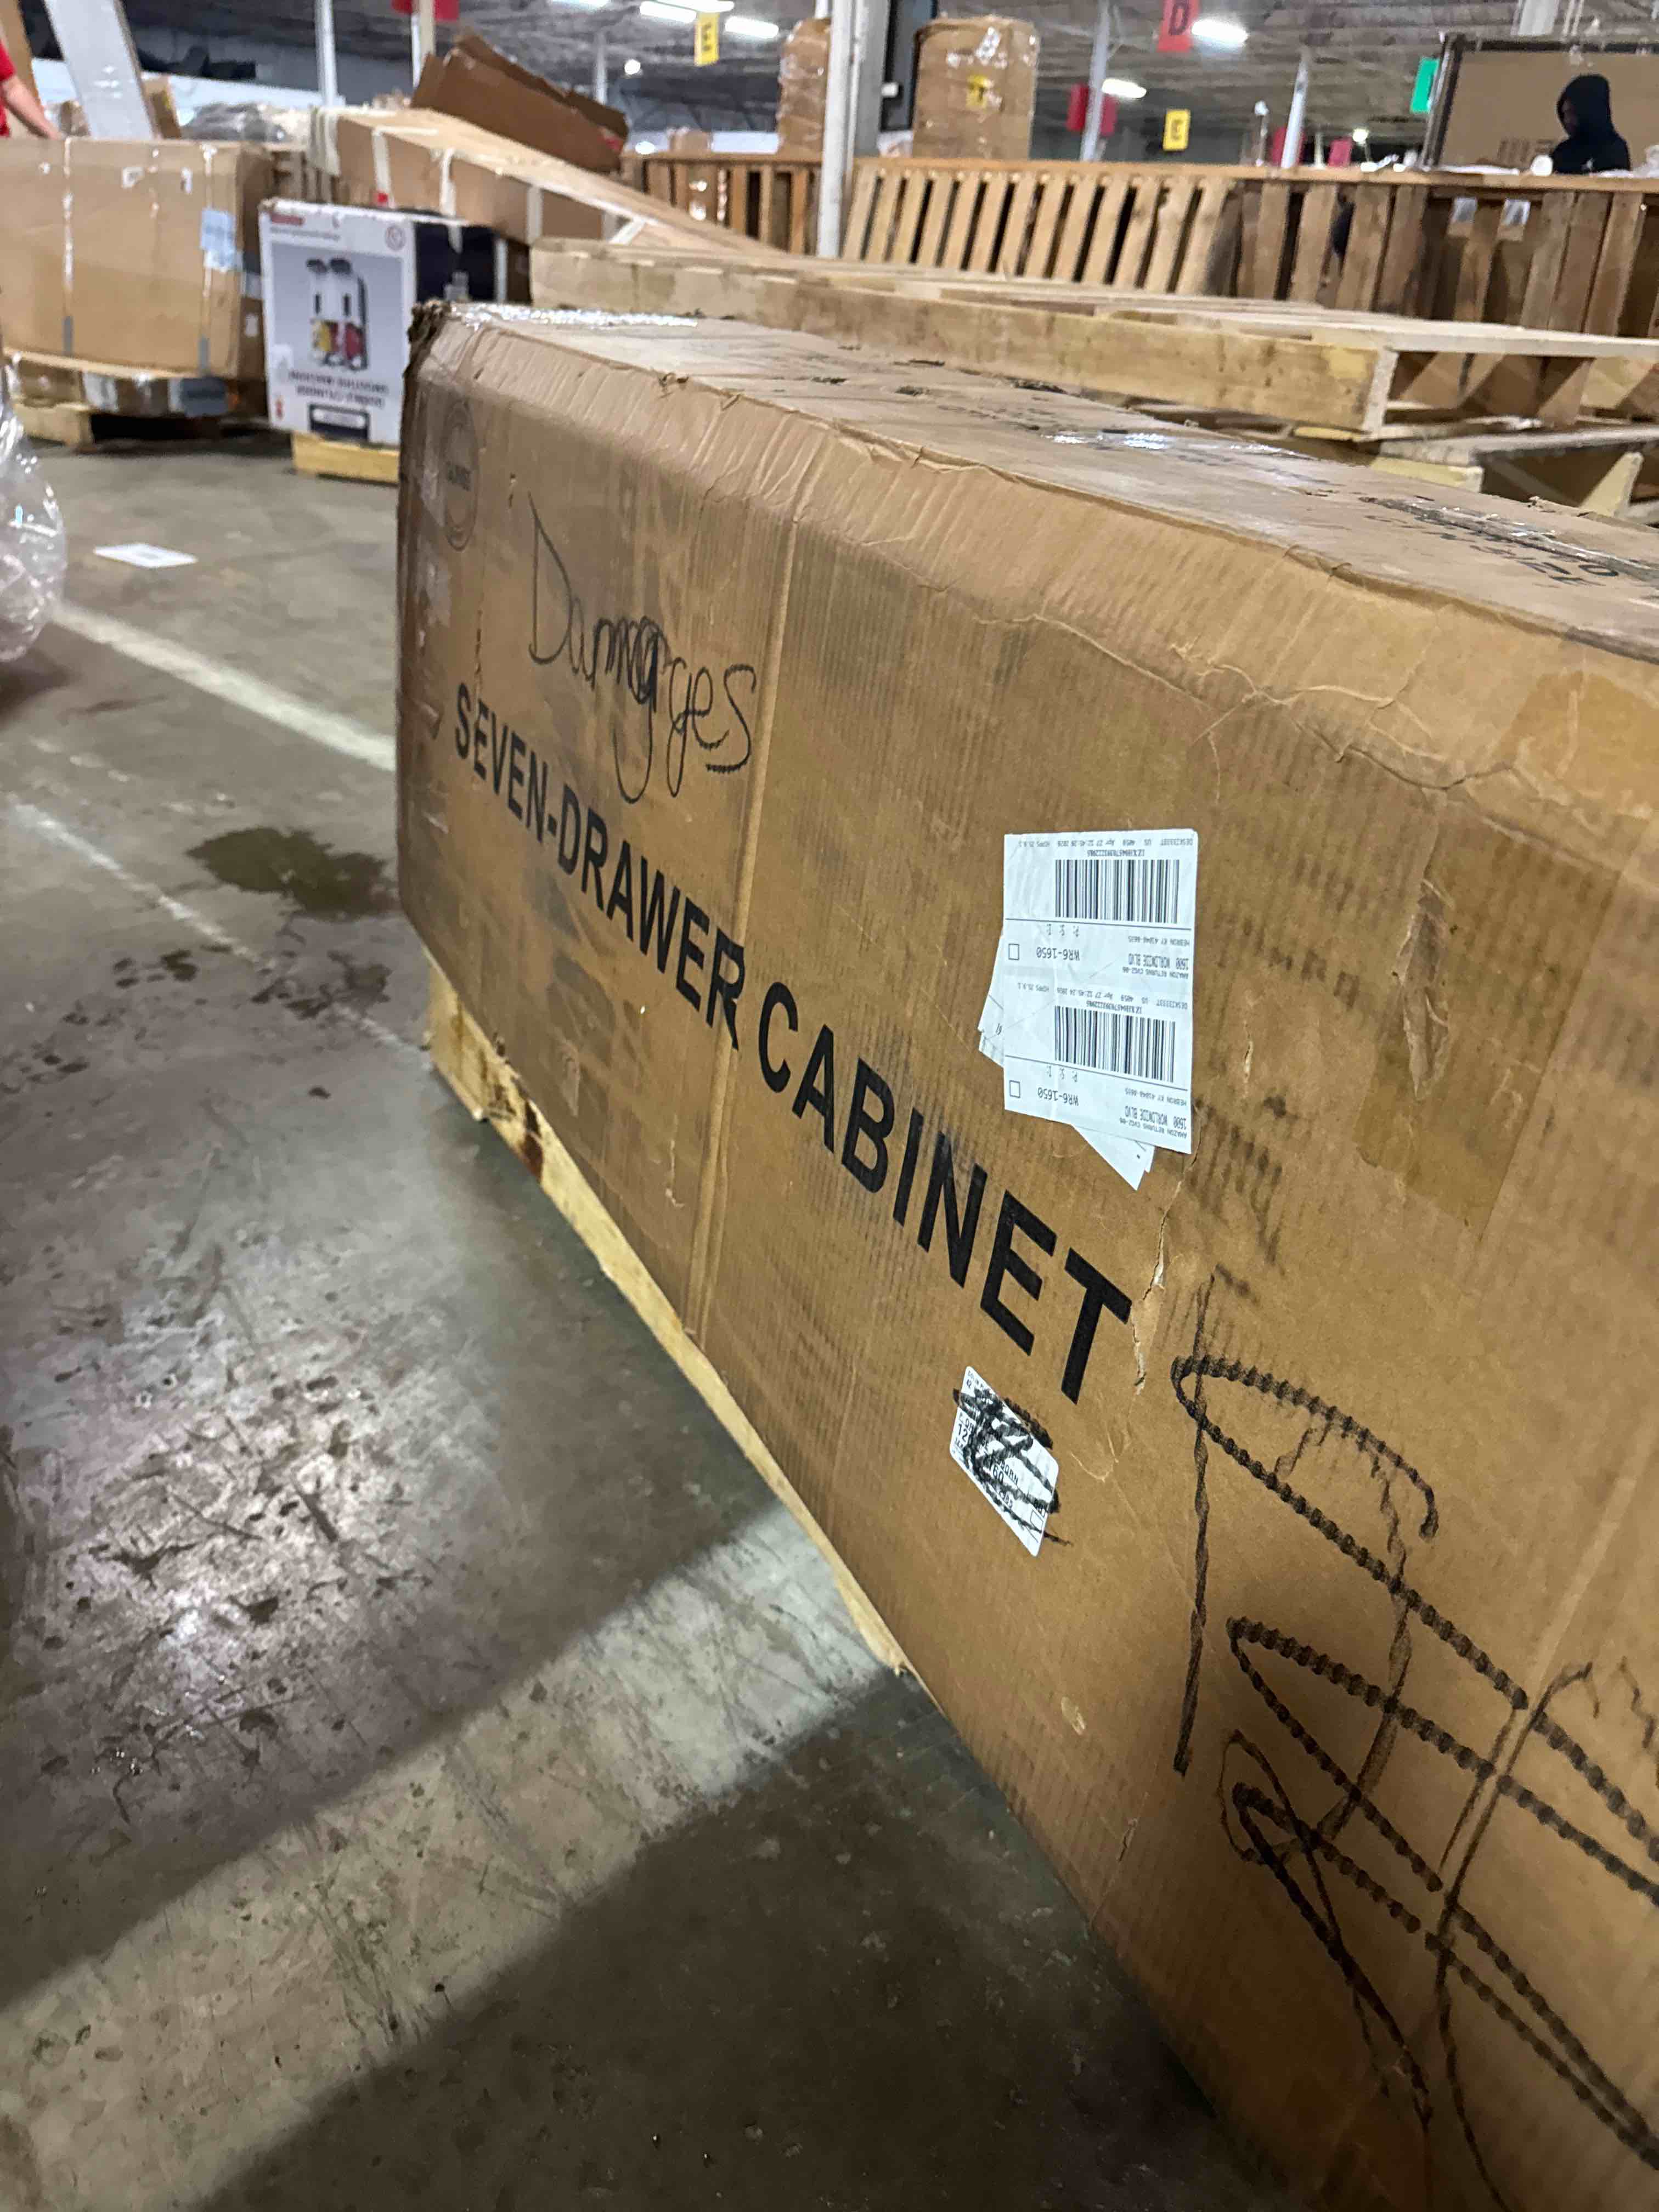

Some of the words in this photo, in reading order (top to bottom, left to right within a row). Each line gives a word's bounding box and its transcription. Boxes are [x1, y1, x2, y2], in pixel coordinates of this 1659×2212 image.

[1169, 0, 1189, 36] D
[1036, 946, 1080, 961] WR6-1650
[1127, 953, 1141, 966] BLVD
[1142, 955, 1170, 968] WORLDWIDE
[1176, 957, 1189, 970] 1600
[1145, 968, 1167, 978] RETURNS
[1169, 971, 1189, 980] AMAZON
[455, 682, 745, 1049] SEVEN-DRAWER
[759, 982, 1132, 1404] CABINET
[1037, 1087, 1079, 1107] WR6-1650
[1125, 1105, 1137, 1119] BLVD
[1139, 1109, 1168, 1126] WORLDWIDE
[1143, 1122, 1165, 1136] RETURNS
[1173, 1115, 1187, 1130] 1600
[1166, 1128, 1188, 1139] AMAZON
